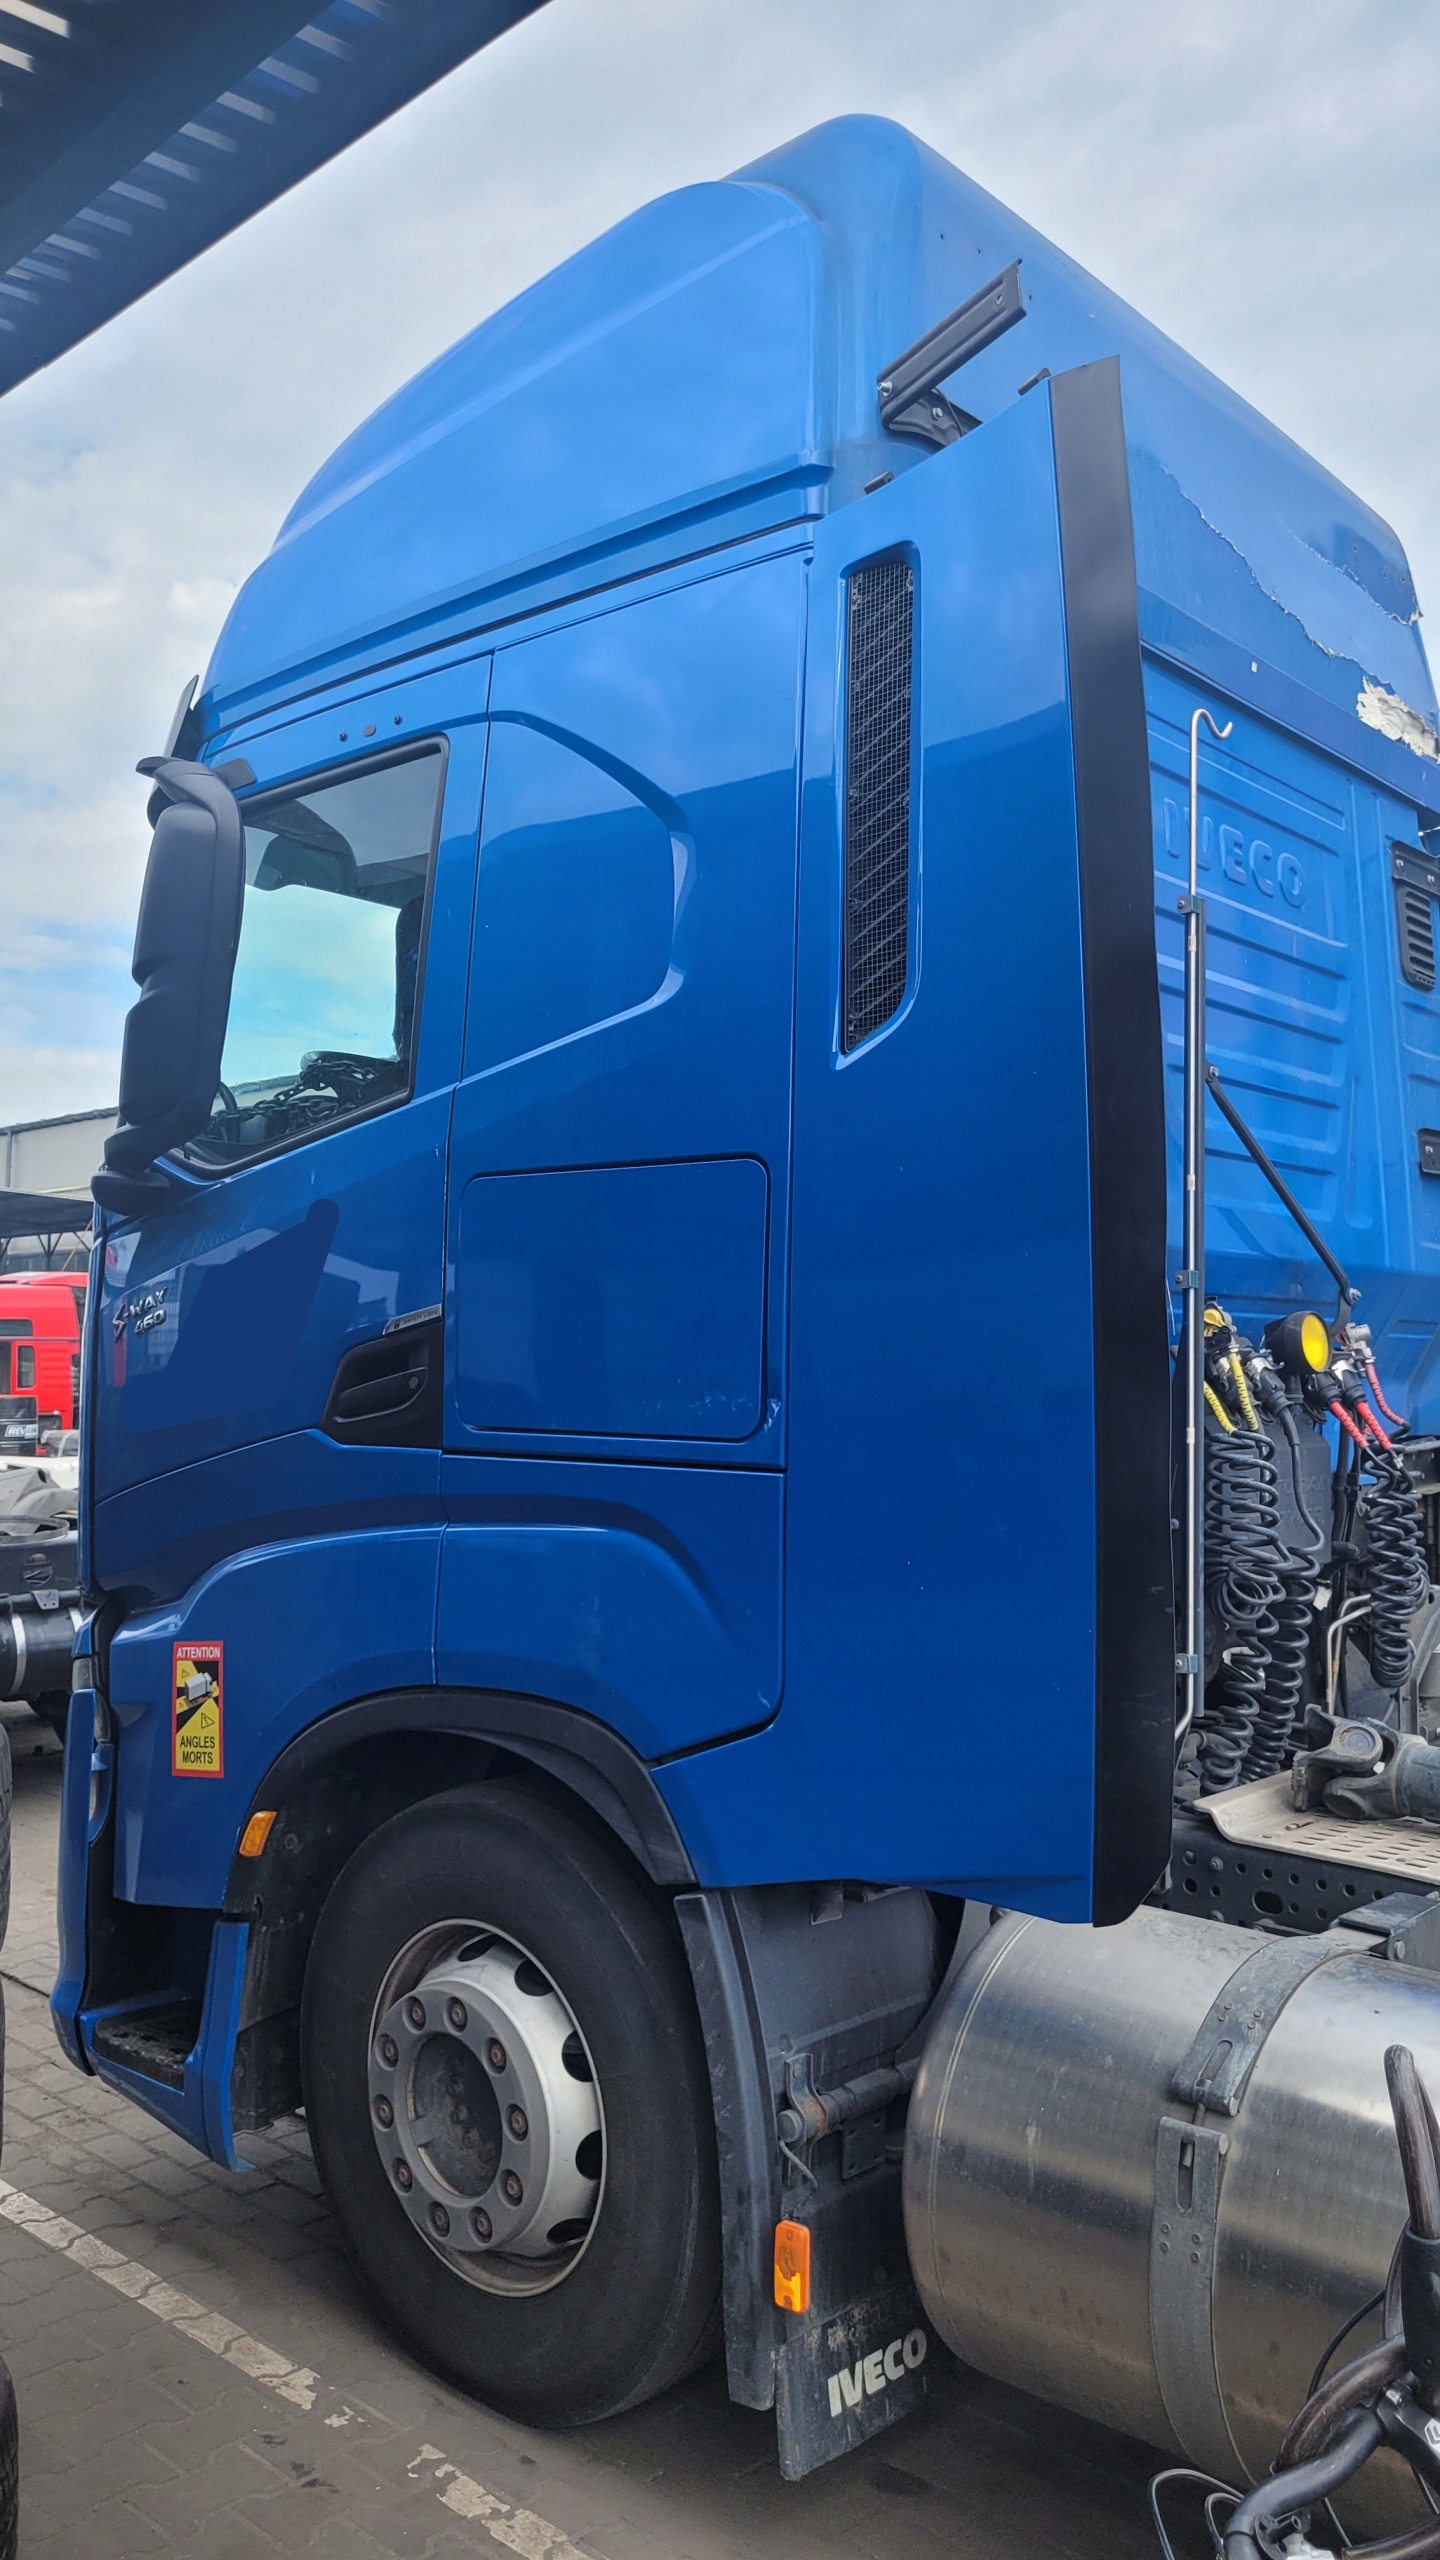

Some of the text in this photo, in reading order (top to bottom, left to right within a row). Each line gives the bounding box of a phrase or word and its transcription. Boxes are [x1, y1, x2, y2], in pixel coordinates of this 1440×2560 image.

[1163, 797, 1306, 909] IVECO
[134, 1309, 168, 1335] 460
[176, 1646, 220, 1659] ATTENTION
[180, 1735, 216, 1749] ANGLES
[182, 1750, 214, 1765] MORTS
[827, 2328, 928, 2418] IVECO
